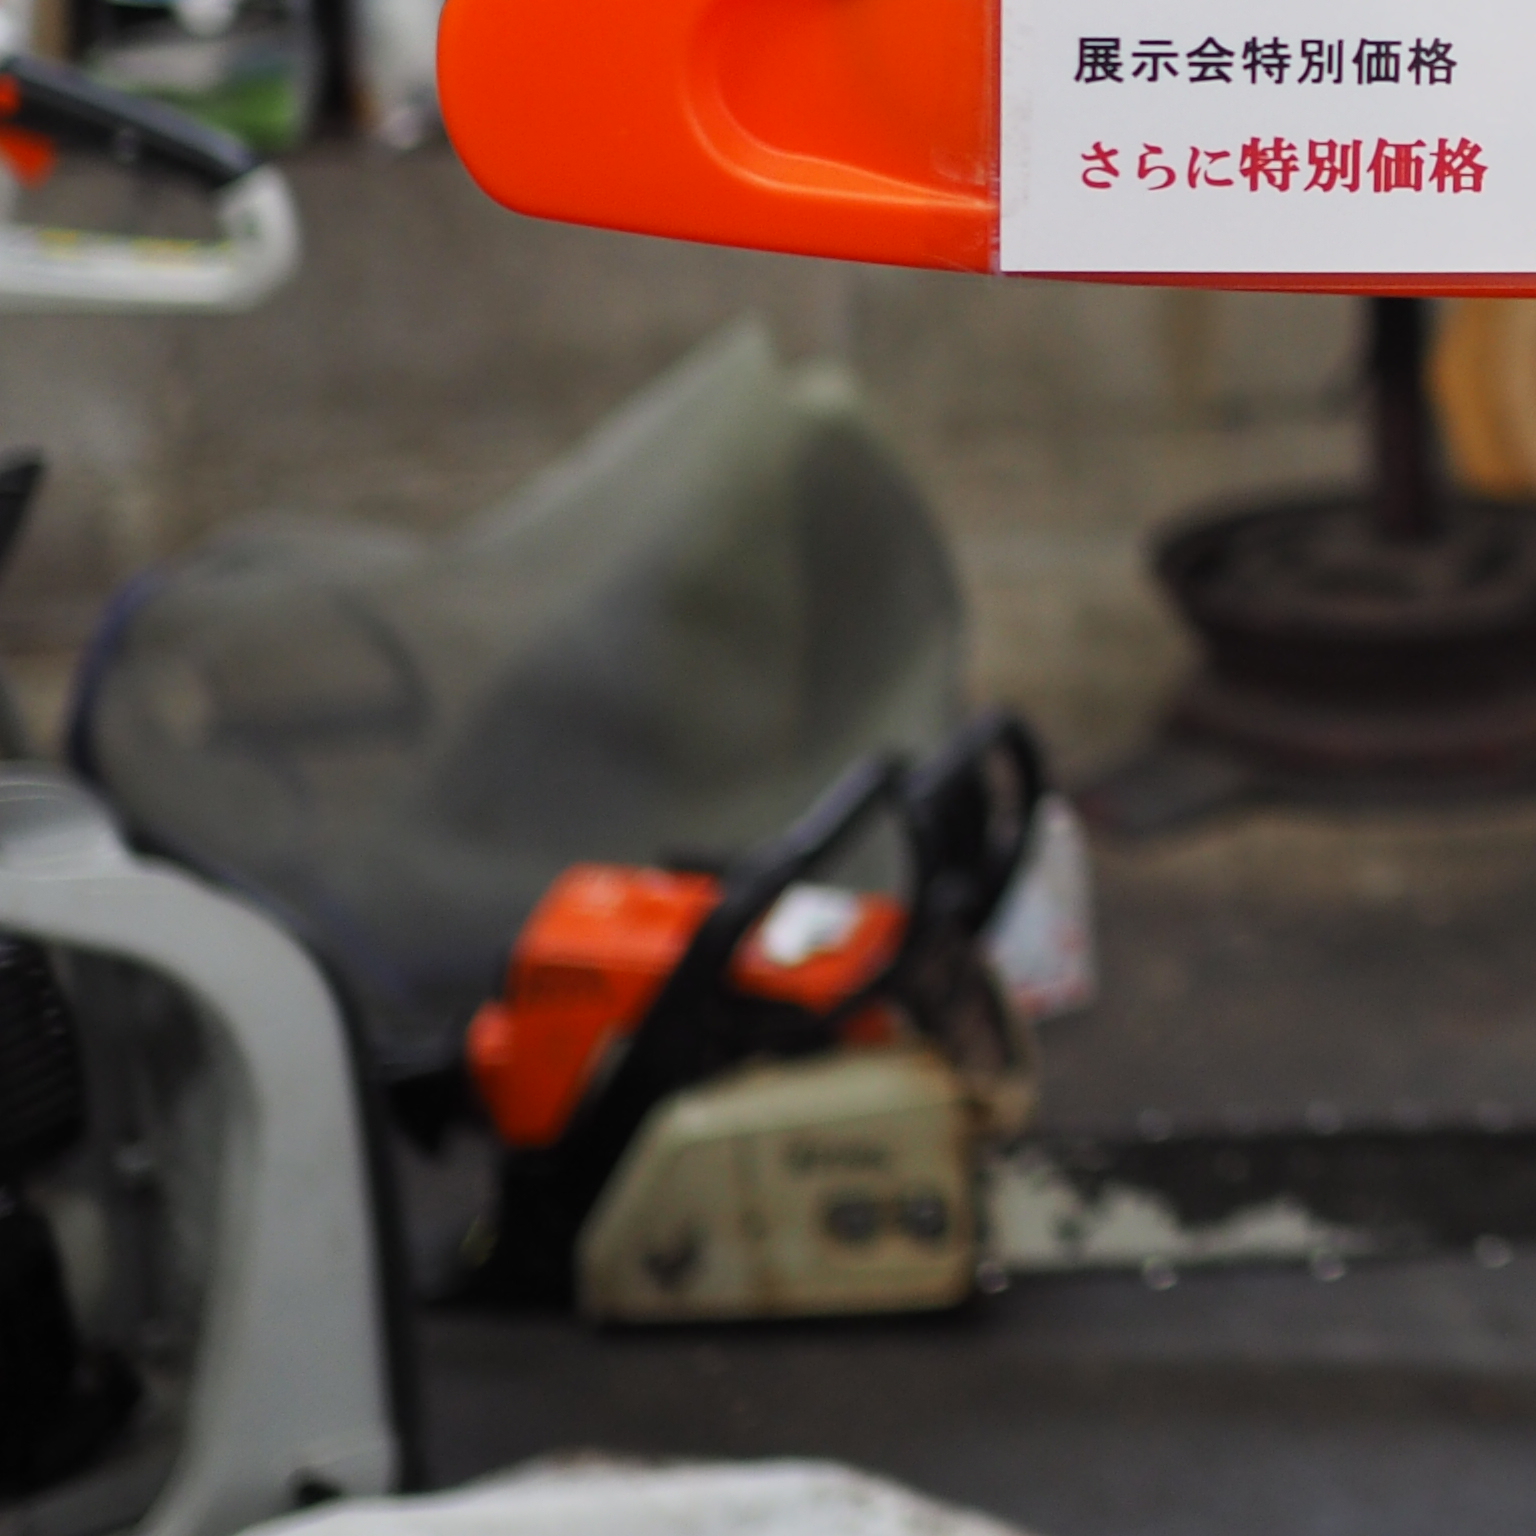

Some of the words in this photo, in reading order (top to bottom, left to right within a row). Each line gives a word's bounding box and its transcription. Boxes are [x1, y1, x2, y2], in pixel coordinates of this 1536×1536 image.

[1074, 36, 1457, 86] 展示会特別価格
[1081, 136, 1488, 194] さらに特別価格
